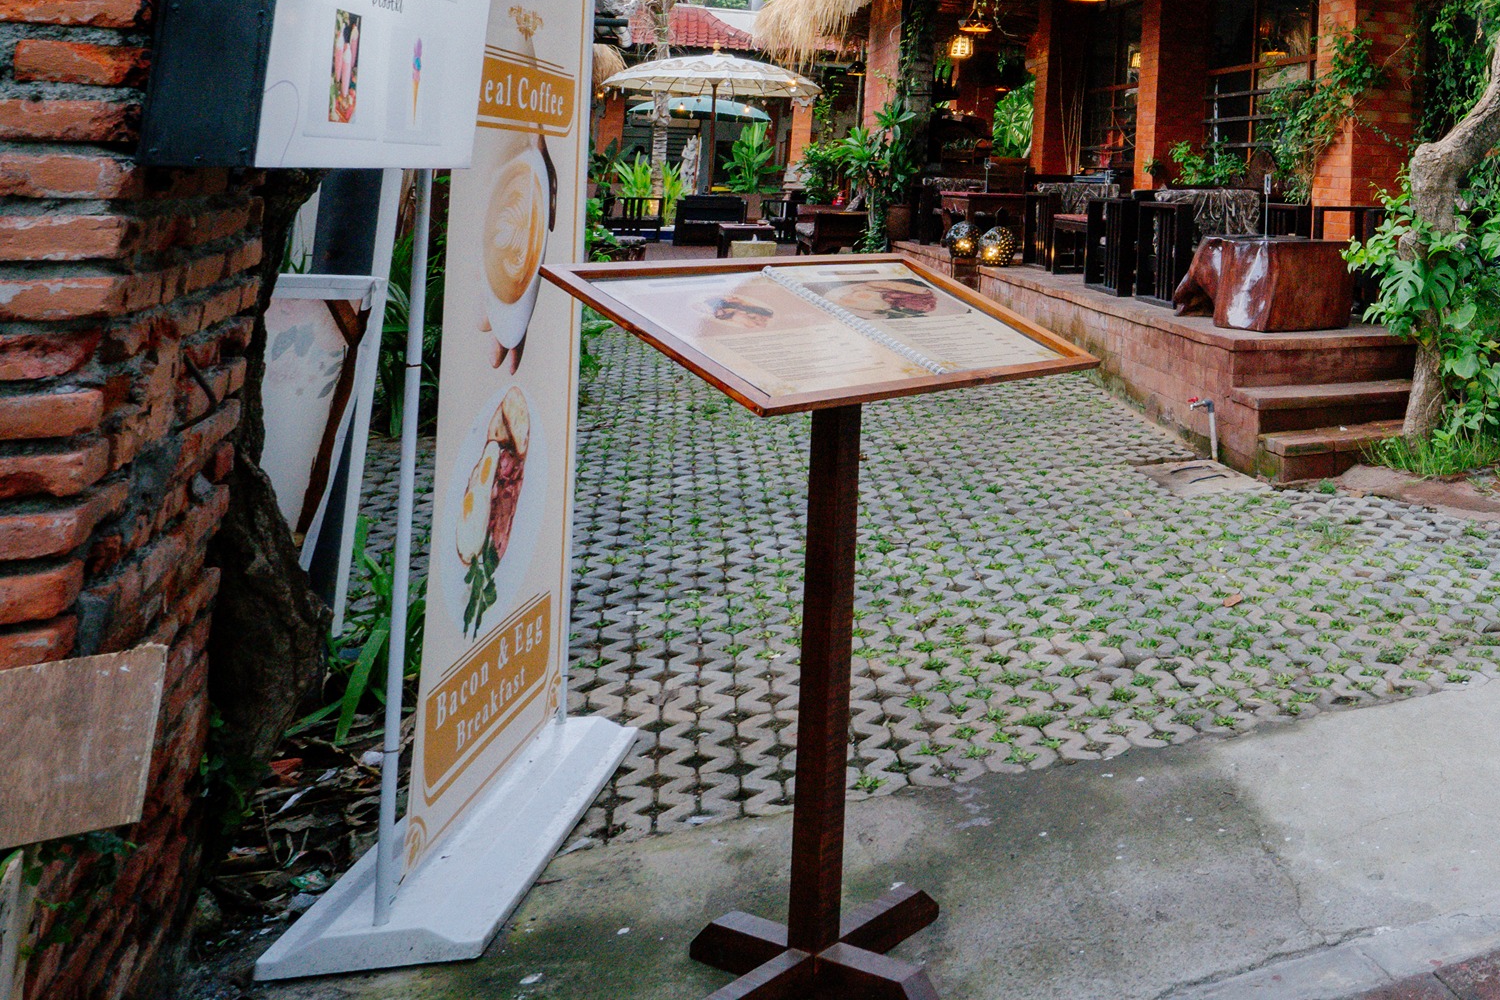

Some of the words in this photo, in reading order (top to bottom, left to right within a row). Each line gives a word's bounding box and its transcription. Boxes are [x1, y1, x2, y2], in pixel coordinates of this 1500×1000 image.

[479, 74, 512, 106] eal
[518, 77, 564, 116] Coffee
[435, 661, 489, 730] Bacon
[497, 636, 509, 670] &
[514, 615, 543, 656] Egg
[456, 665, 525, 752] Breakfast
